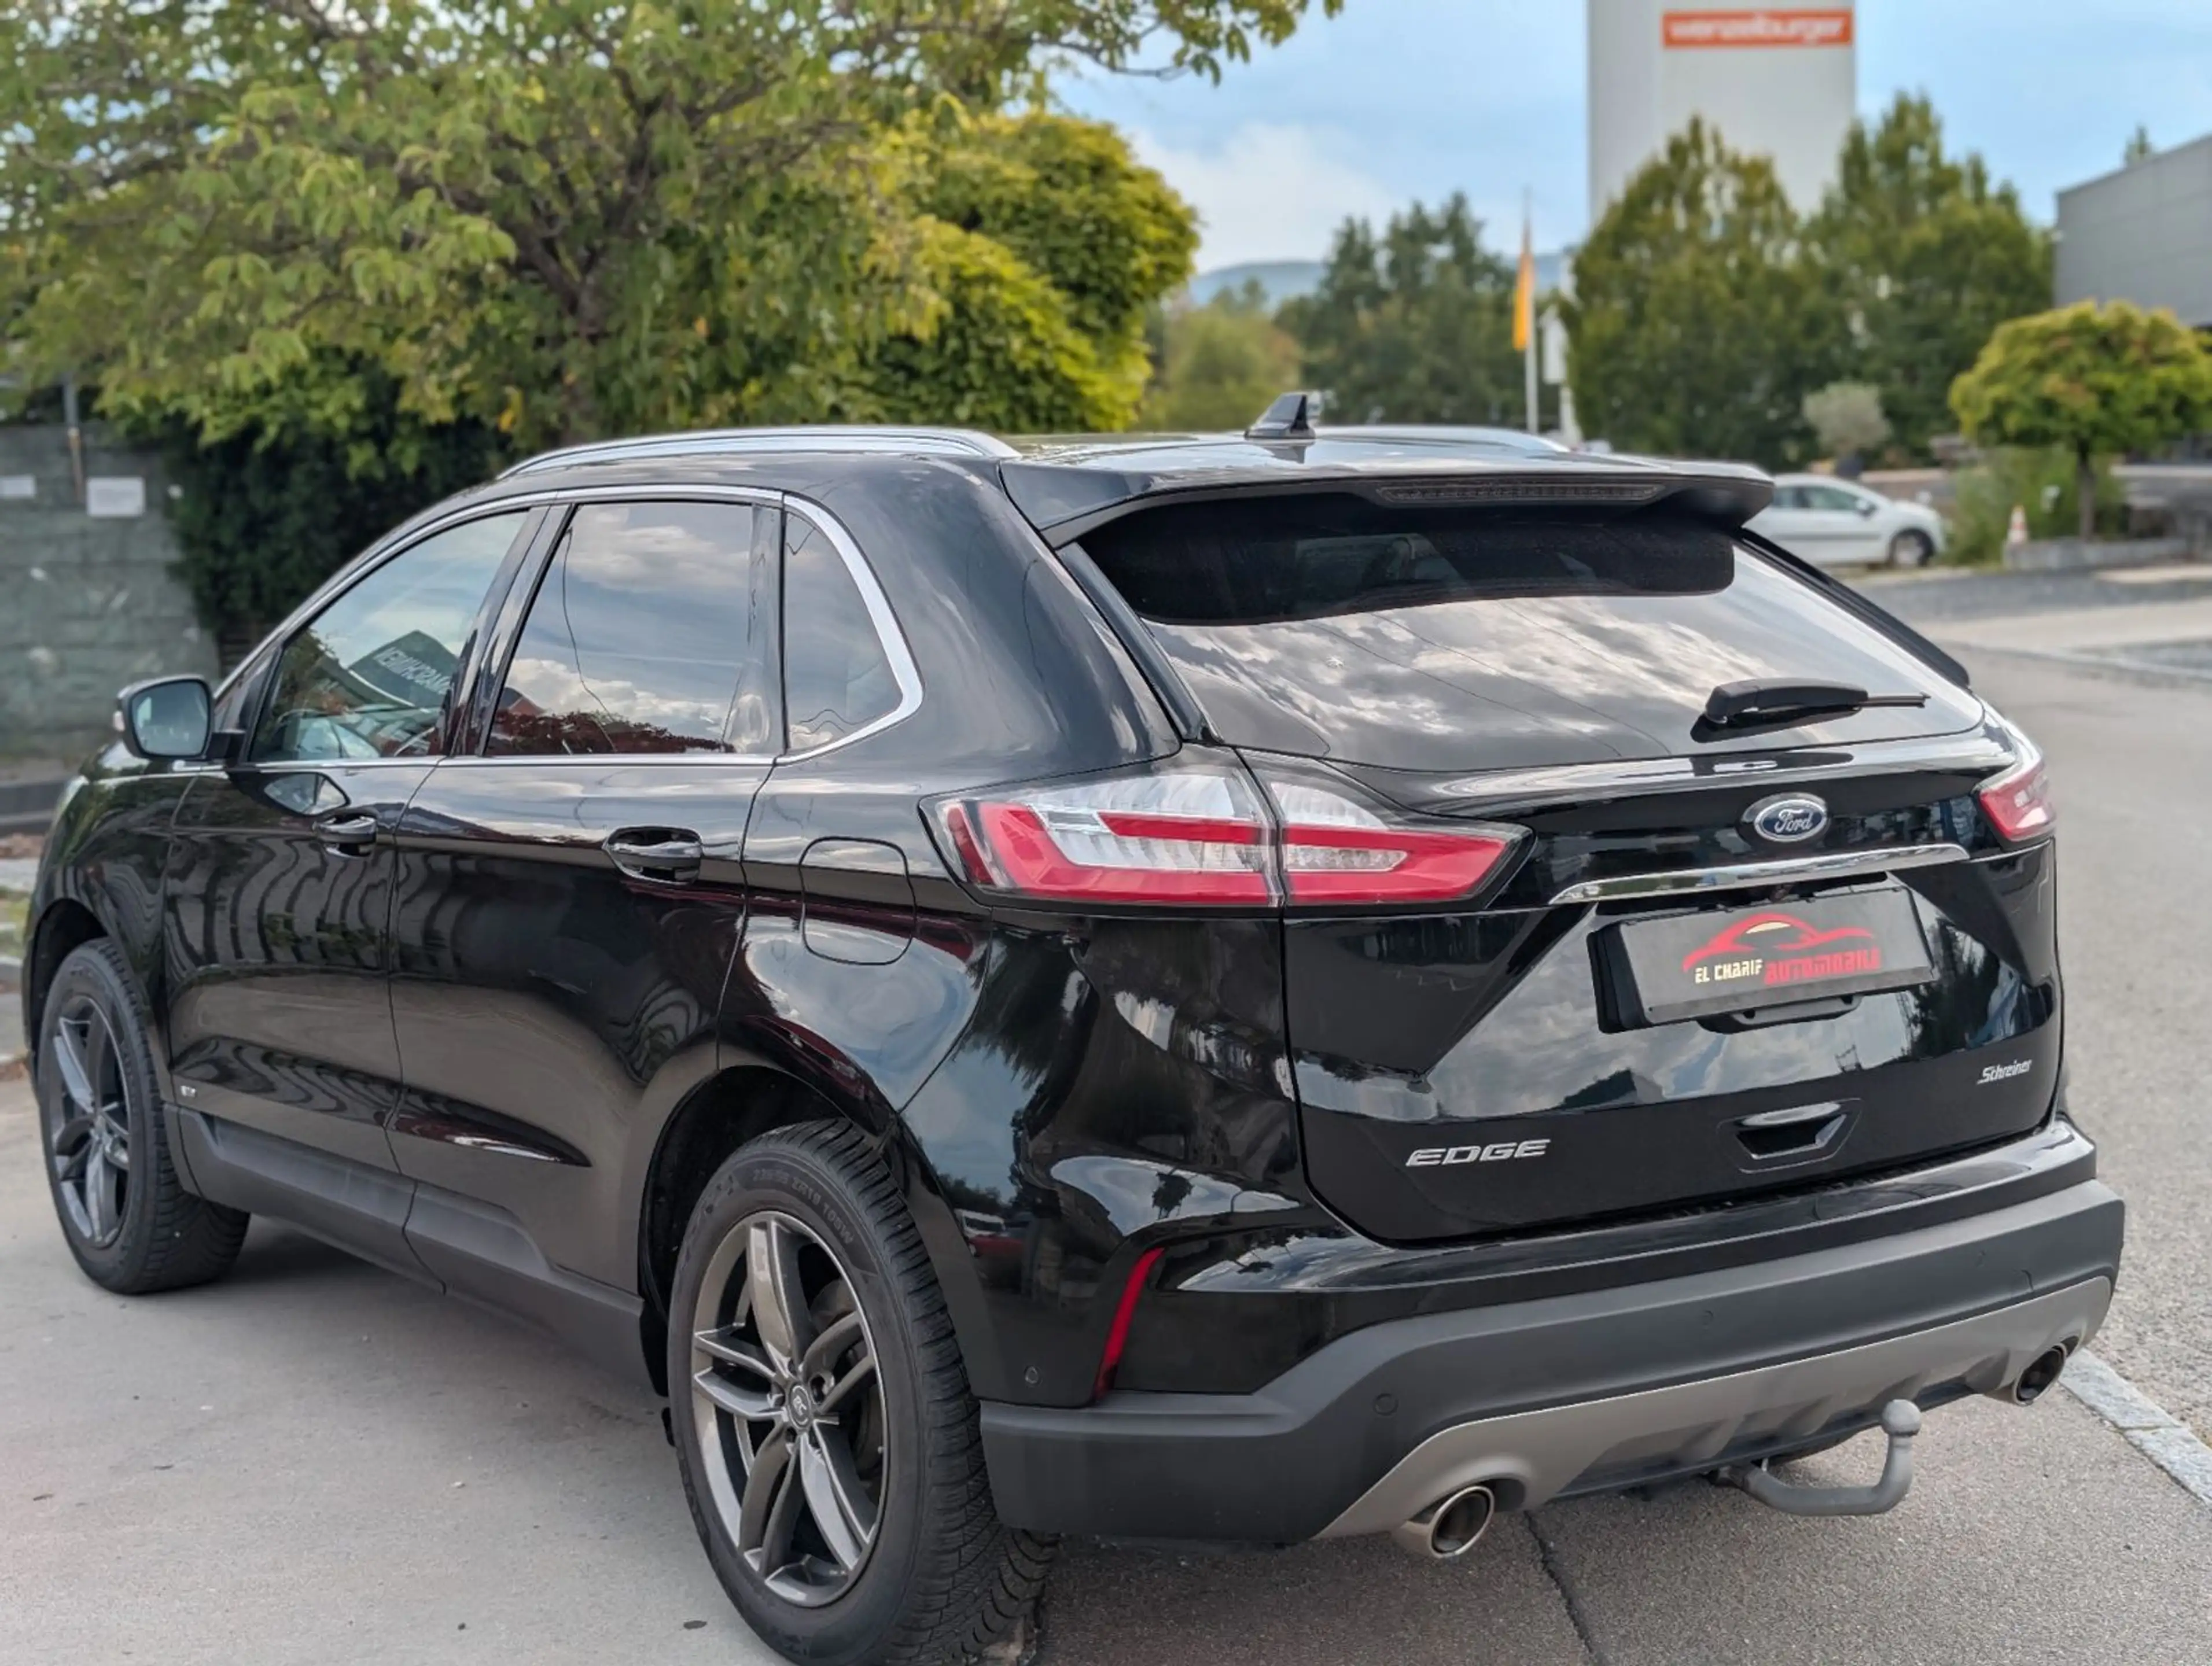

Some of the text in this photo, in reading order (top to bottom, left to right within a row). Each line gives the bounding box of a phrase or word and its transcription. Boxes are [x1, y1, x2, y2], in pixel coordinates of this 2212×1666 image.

[1773, 809, 1814, 834] Ford
[1695, 967, 1710, 984] EL
[1714, 959, 1764, 981] CHARIF
[1405, 1138, 1551, 1167] EDGE
